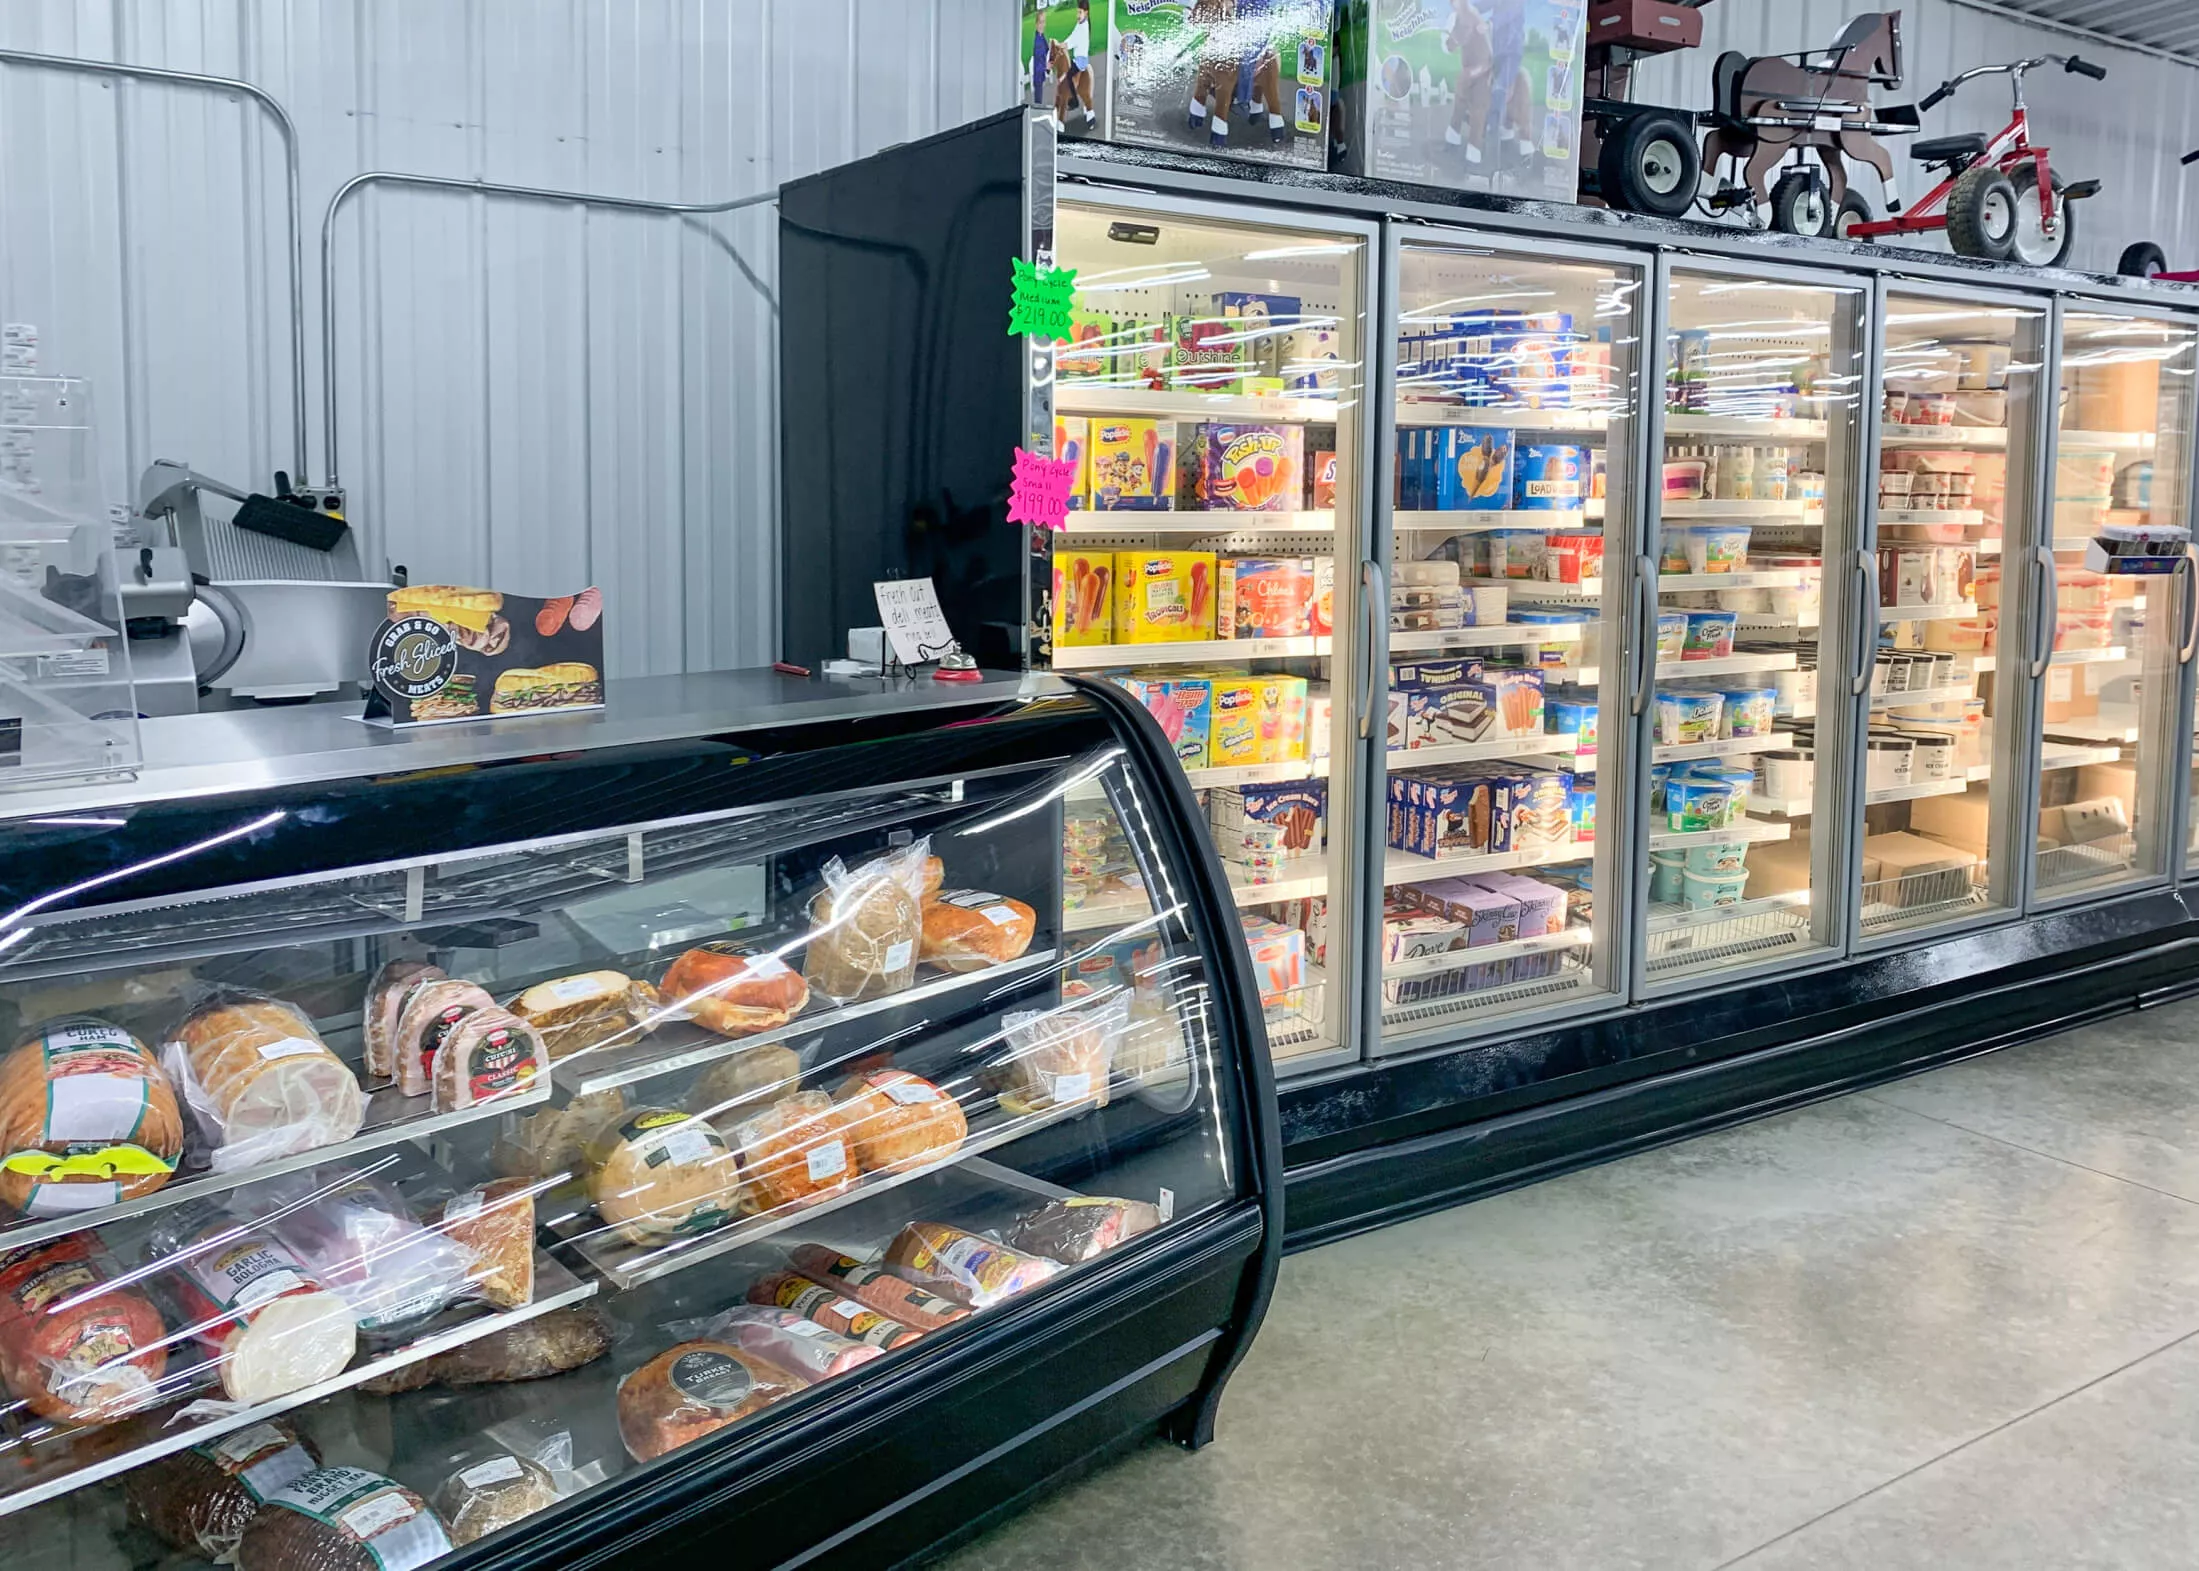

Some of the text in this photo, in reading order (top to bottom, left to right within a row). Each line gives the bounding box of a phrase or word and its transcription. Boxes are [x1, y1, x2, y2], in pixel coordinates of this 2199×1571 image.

[1020, 291, 1061, 306] Medium
[1176, 348, 1241, 365] Outshine
[1022, 459, 1047, 479] Pony
[1022, 478, 1052, 491] Small
[385, 620, 440, 648] GRAB & GO
[372, 630, 457, 682] Fresh Sliced
[407, 675, 444, 694] MEATS
[1440, 690, 1484, 704] ORIGINAL
[487, 1066, 519, 1082] CLASSIC
[225, 1249, 273, 1277] GARLIC
[233, 1257, 282, 1284] BOLOGNA
[685, 1363, 732, 1382] TURKEY
[695, 1369, 731, 1384] BREAST
[305, 1469, 352, 1495] BRAND
[307, 1480, 347, 1505] NUGGET
